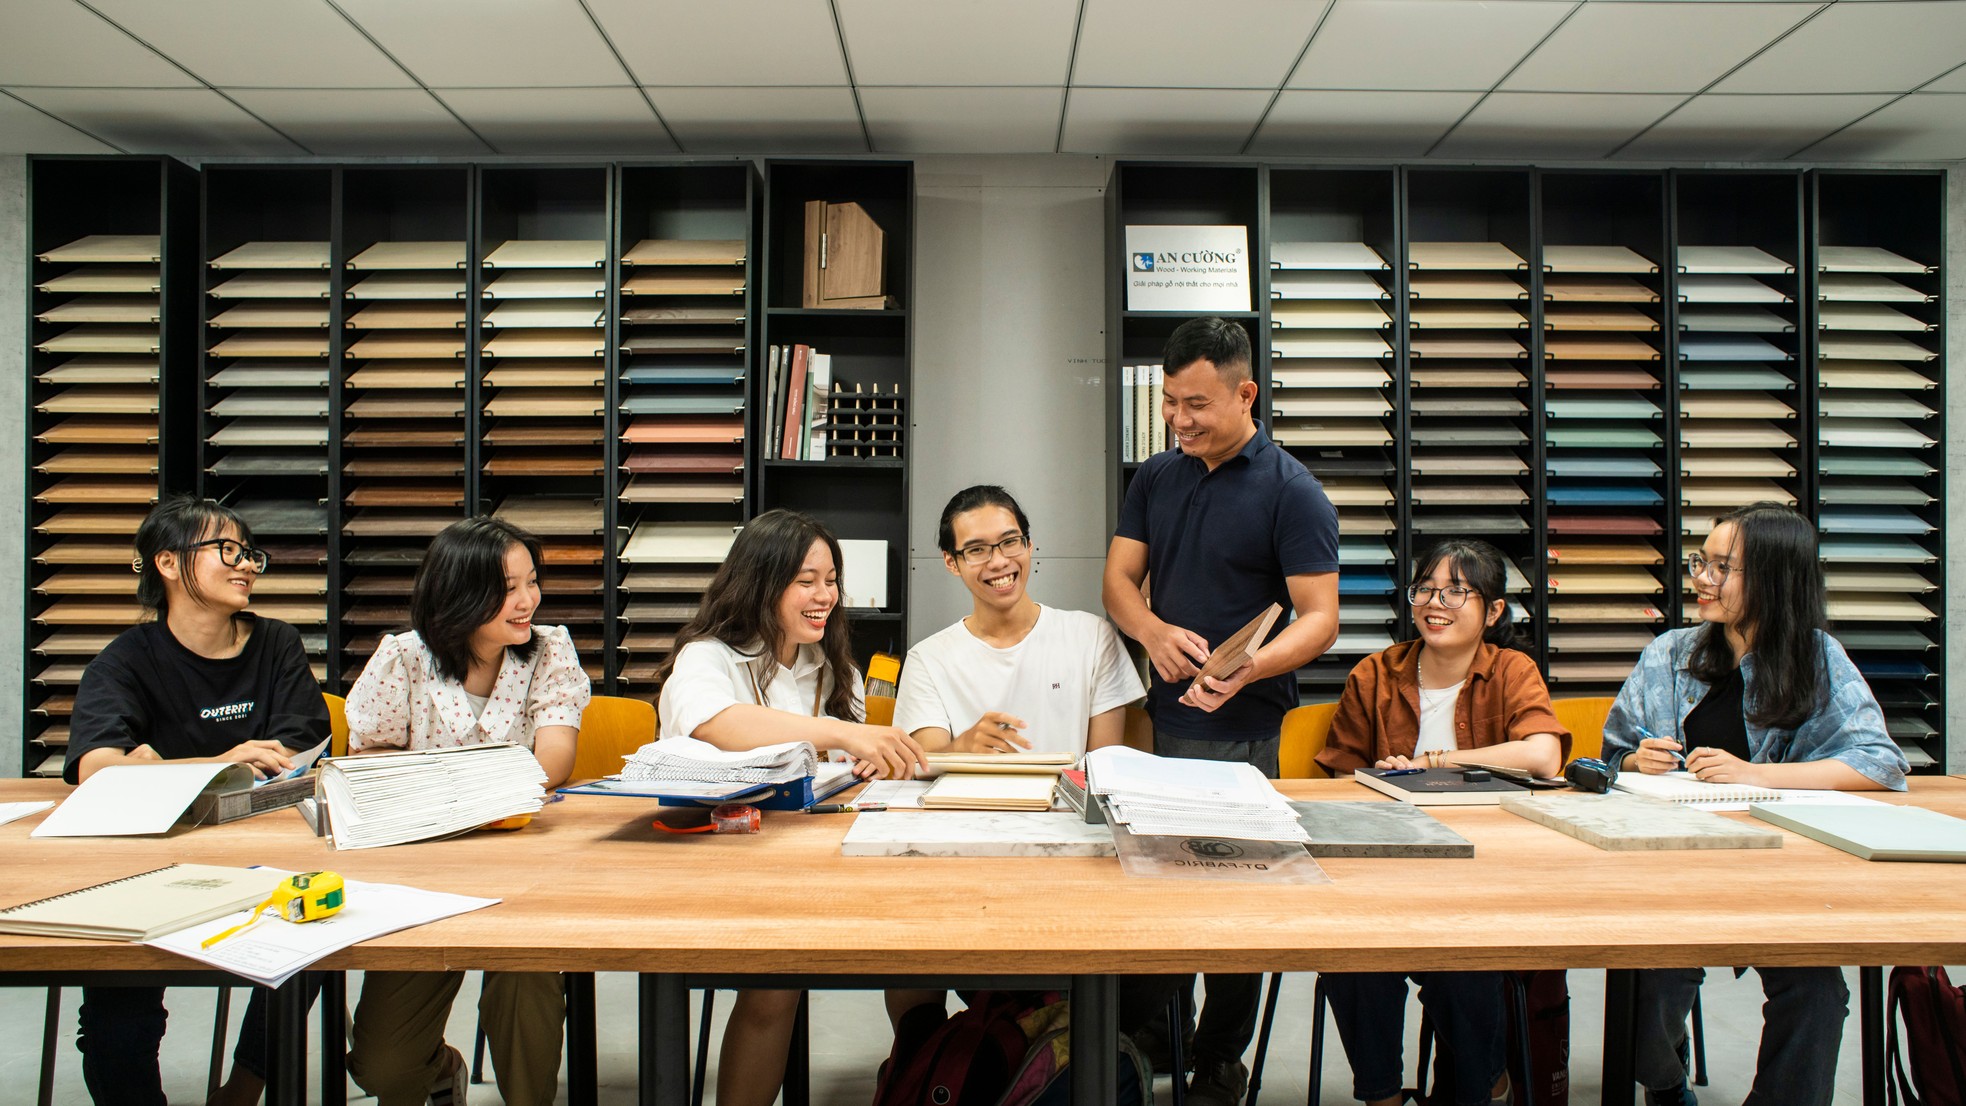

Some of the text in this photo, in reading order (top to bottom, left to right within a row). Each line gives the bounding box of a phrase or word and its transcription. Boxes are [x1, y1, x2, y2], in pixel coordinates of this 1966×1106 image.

[1156, 252, 1177, 263] AN
[1180, 266, 1207, 274] Working
[200, 701, 255, 719] OUTERITY
